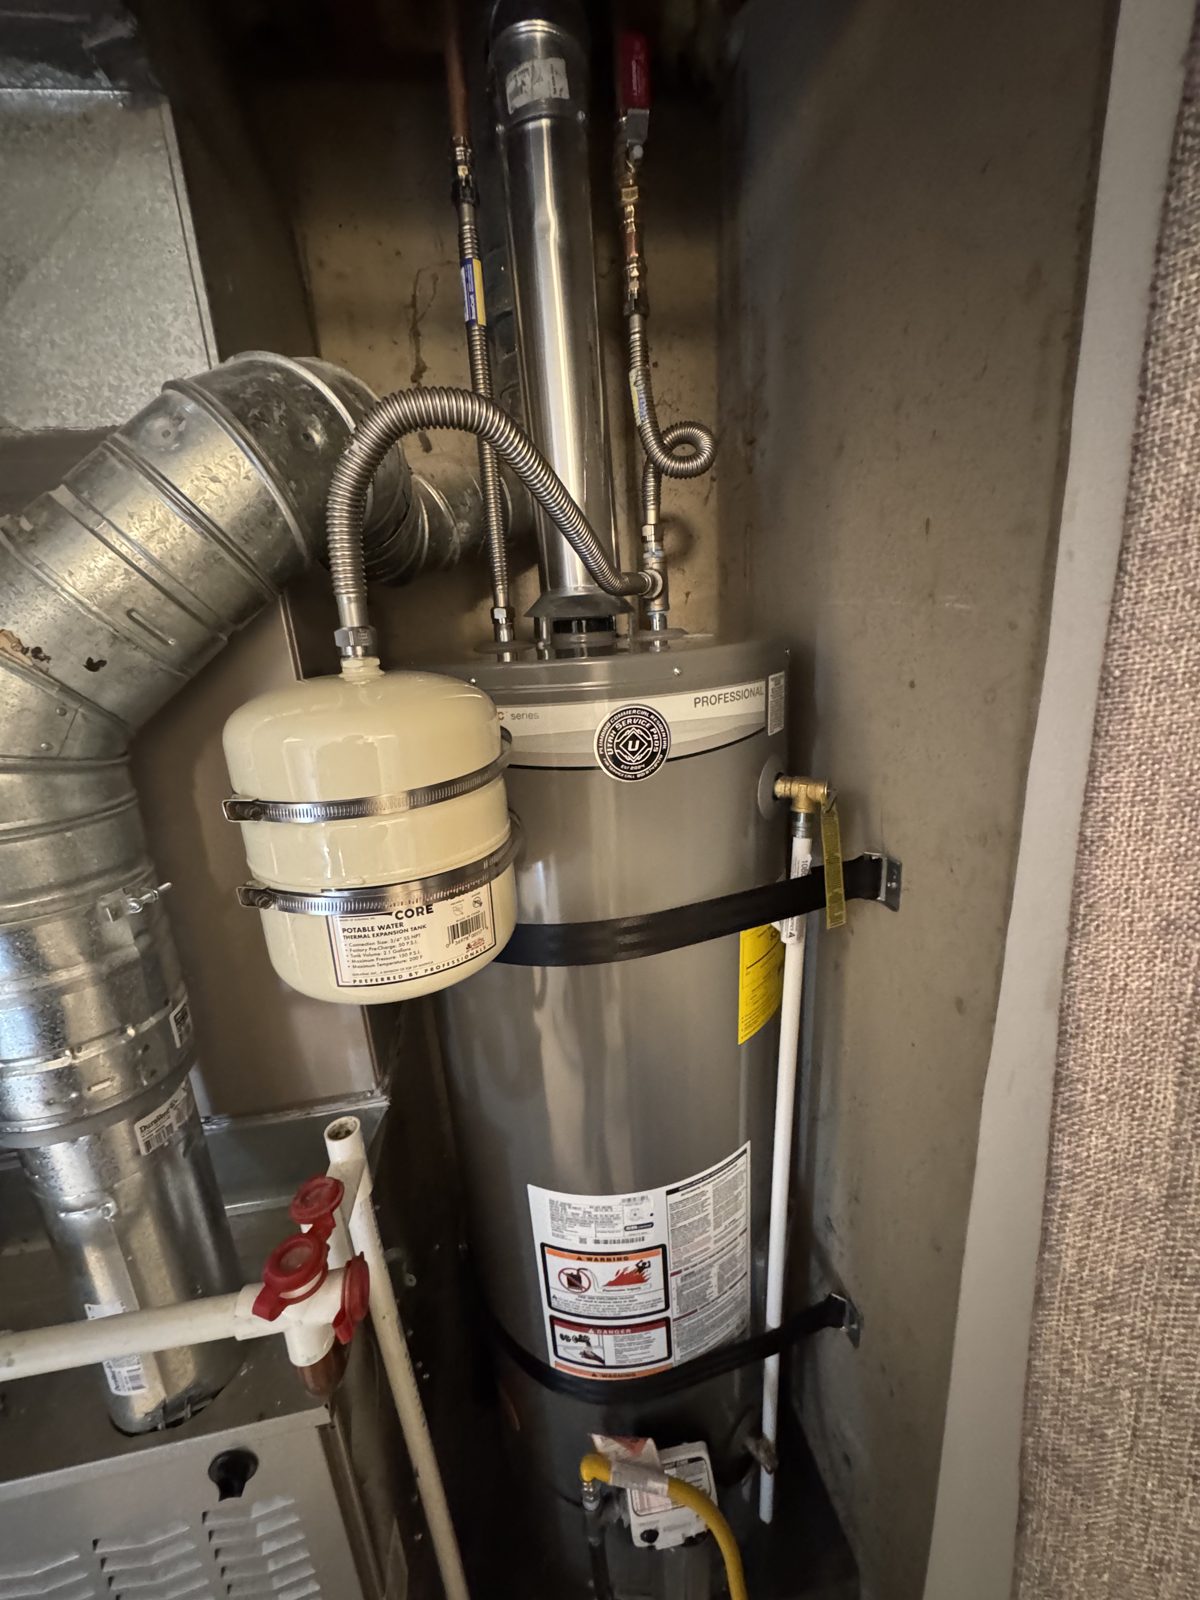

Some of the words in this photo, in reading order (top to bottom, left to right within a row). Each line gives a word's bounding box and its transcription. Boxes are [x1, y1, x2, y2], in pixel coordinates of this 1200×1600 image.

[693, 686, 764, 709] PROFESSIONAL
[510, 711, 540, 721] series
[606, 729, 617, 755] UTAH
[615, 718, 652, 731] SERVICE
[650, 728, 660, 753] PROS
[628, 741, 640, 752] U
[395, 904, 434, 920] CORE
[342, 926, 375, 934] POTABLE
[377, 922, 404, 931] WATER
[372, 929, 409, 938] EXPANSION
[410, 924, 427, 932] TANK
[586, 1255, 630, 1263] WARNING
[596, 1327, 632, 1335] DANGER
